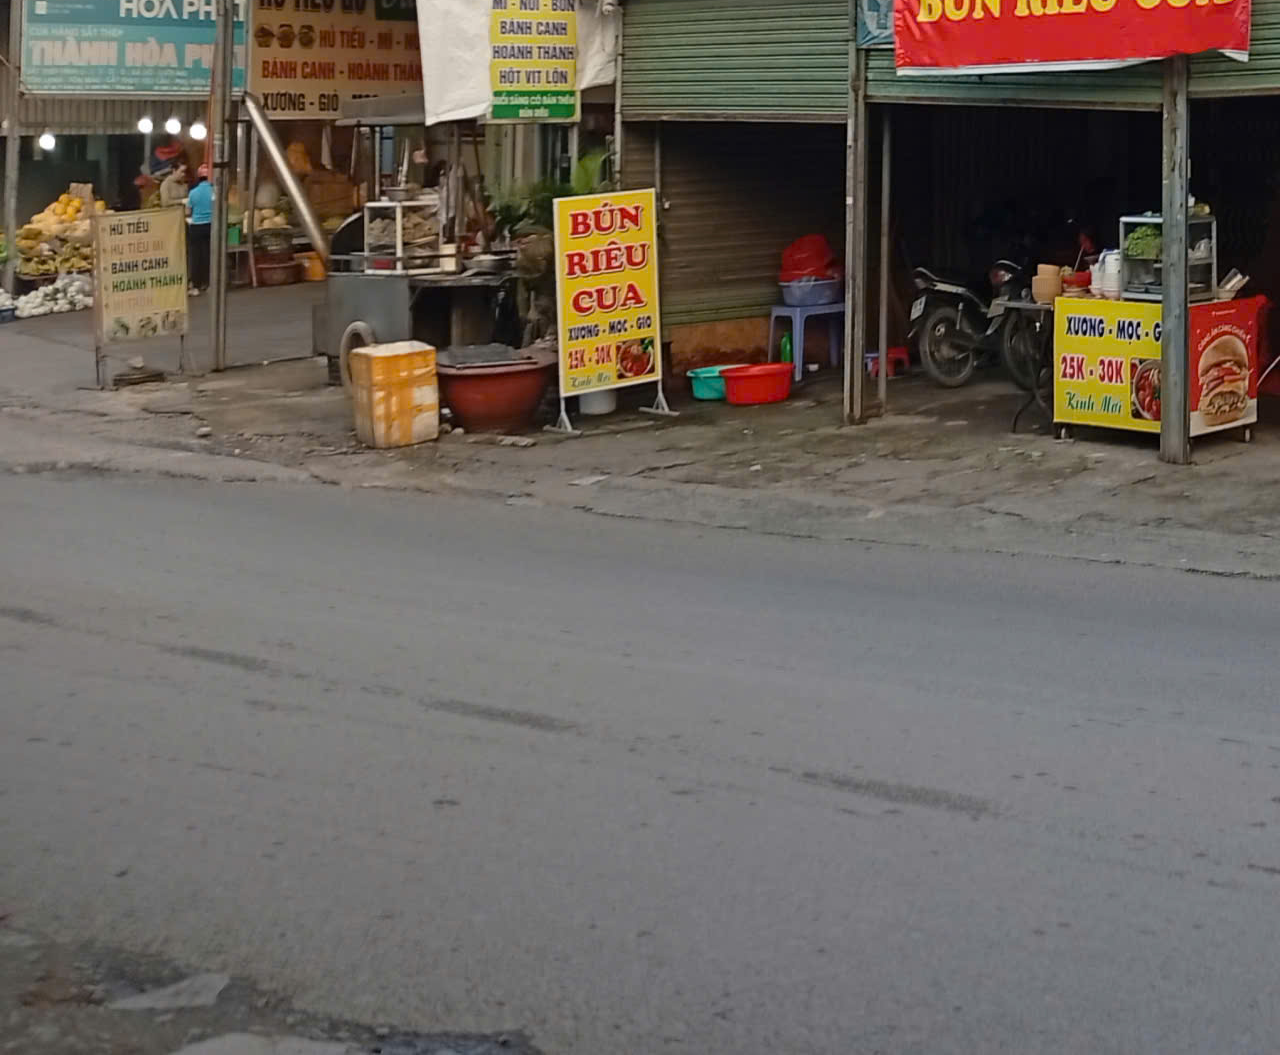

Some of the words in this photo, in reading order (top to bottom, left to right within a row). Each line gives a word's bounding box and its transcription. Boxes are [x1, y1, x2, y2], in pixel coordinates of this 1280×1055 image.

[500, 19, 532, 35] BÁNH
[536, 21, 568, 36] CANH
[302, 60, 336, 80] CANH
[569, 202, 643, 238] BÚN
[565, 239, 649, 278] RIÊU
[572, 282, 647, 316] CUA
[1061, 354, 1086, 380] 25K
[1099, 357, 1125, 385] 30K
